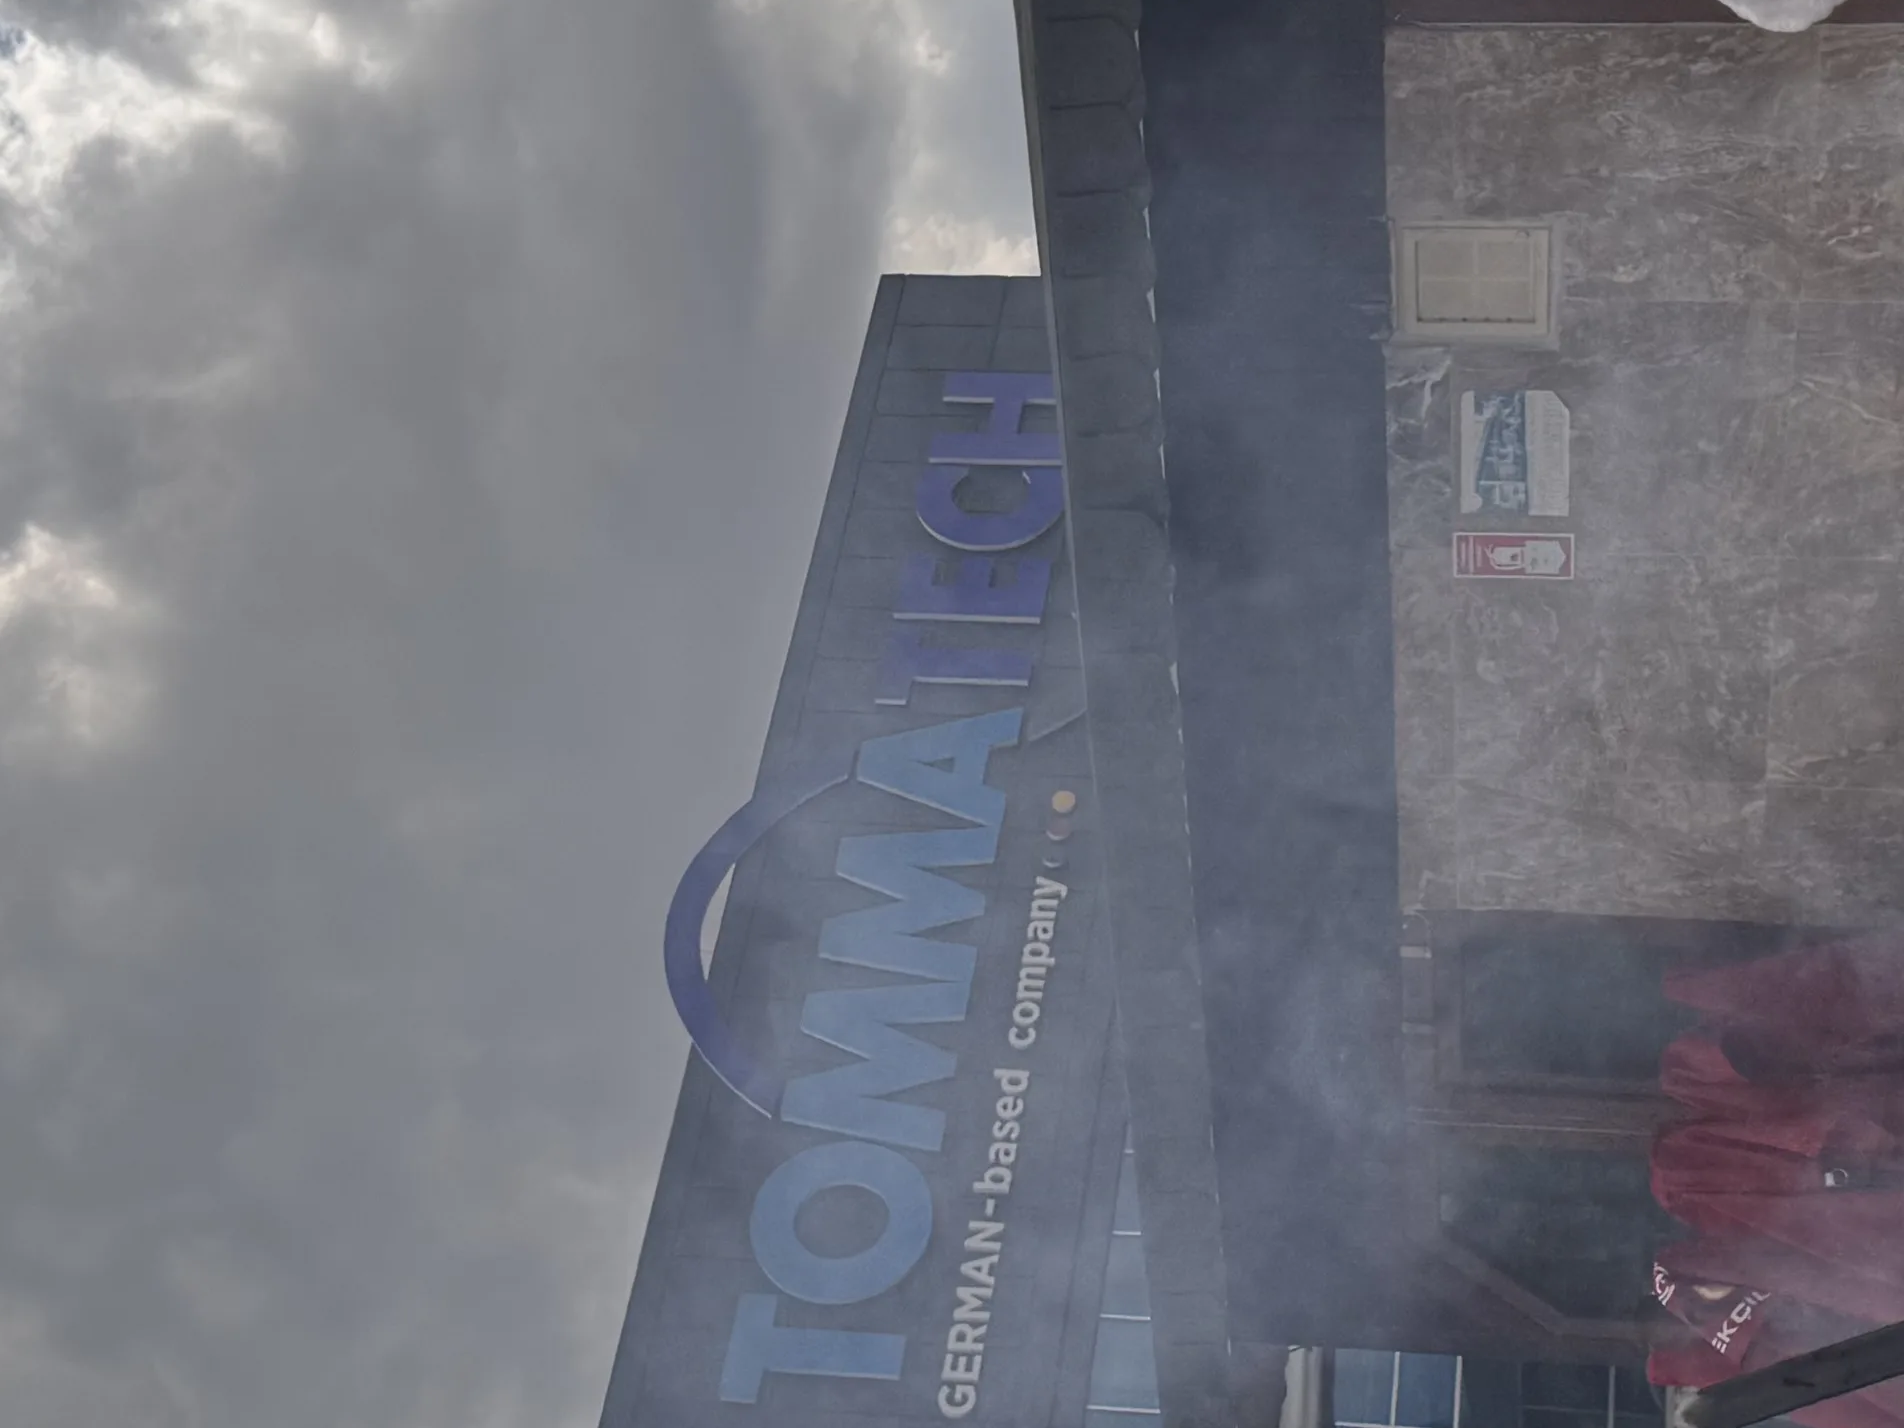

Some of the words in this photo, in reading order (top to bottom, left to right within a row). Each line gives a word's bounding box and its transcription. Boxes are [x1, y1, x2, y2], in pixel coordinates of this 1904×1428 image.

[718, 369, 1066, 1404] TOMMATECH
[936, 1067, 1032, 1420] GERMAN-based
[1006, 874, 1069, 1050] company
